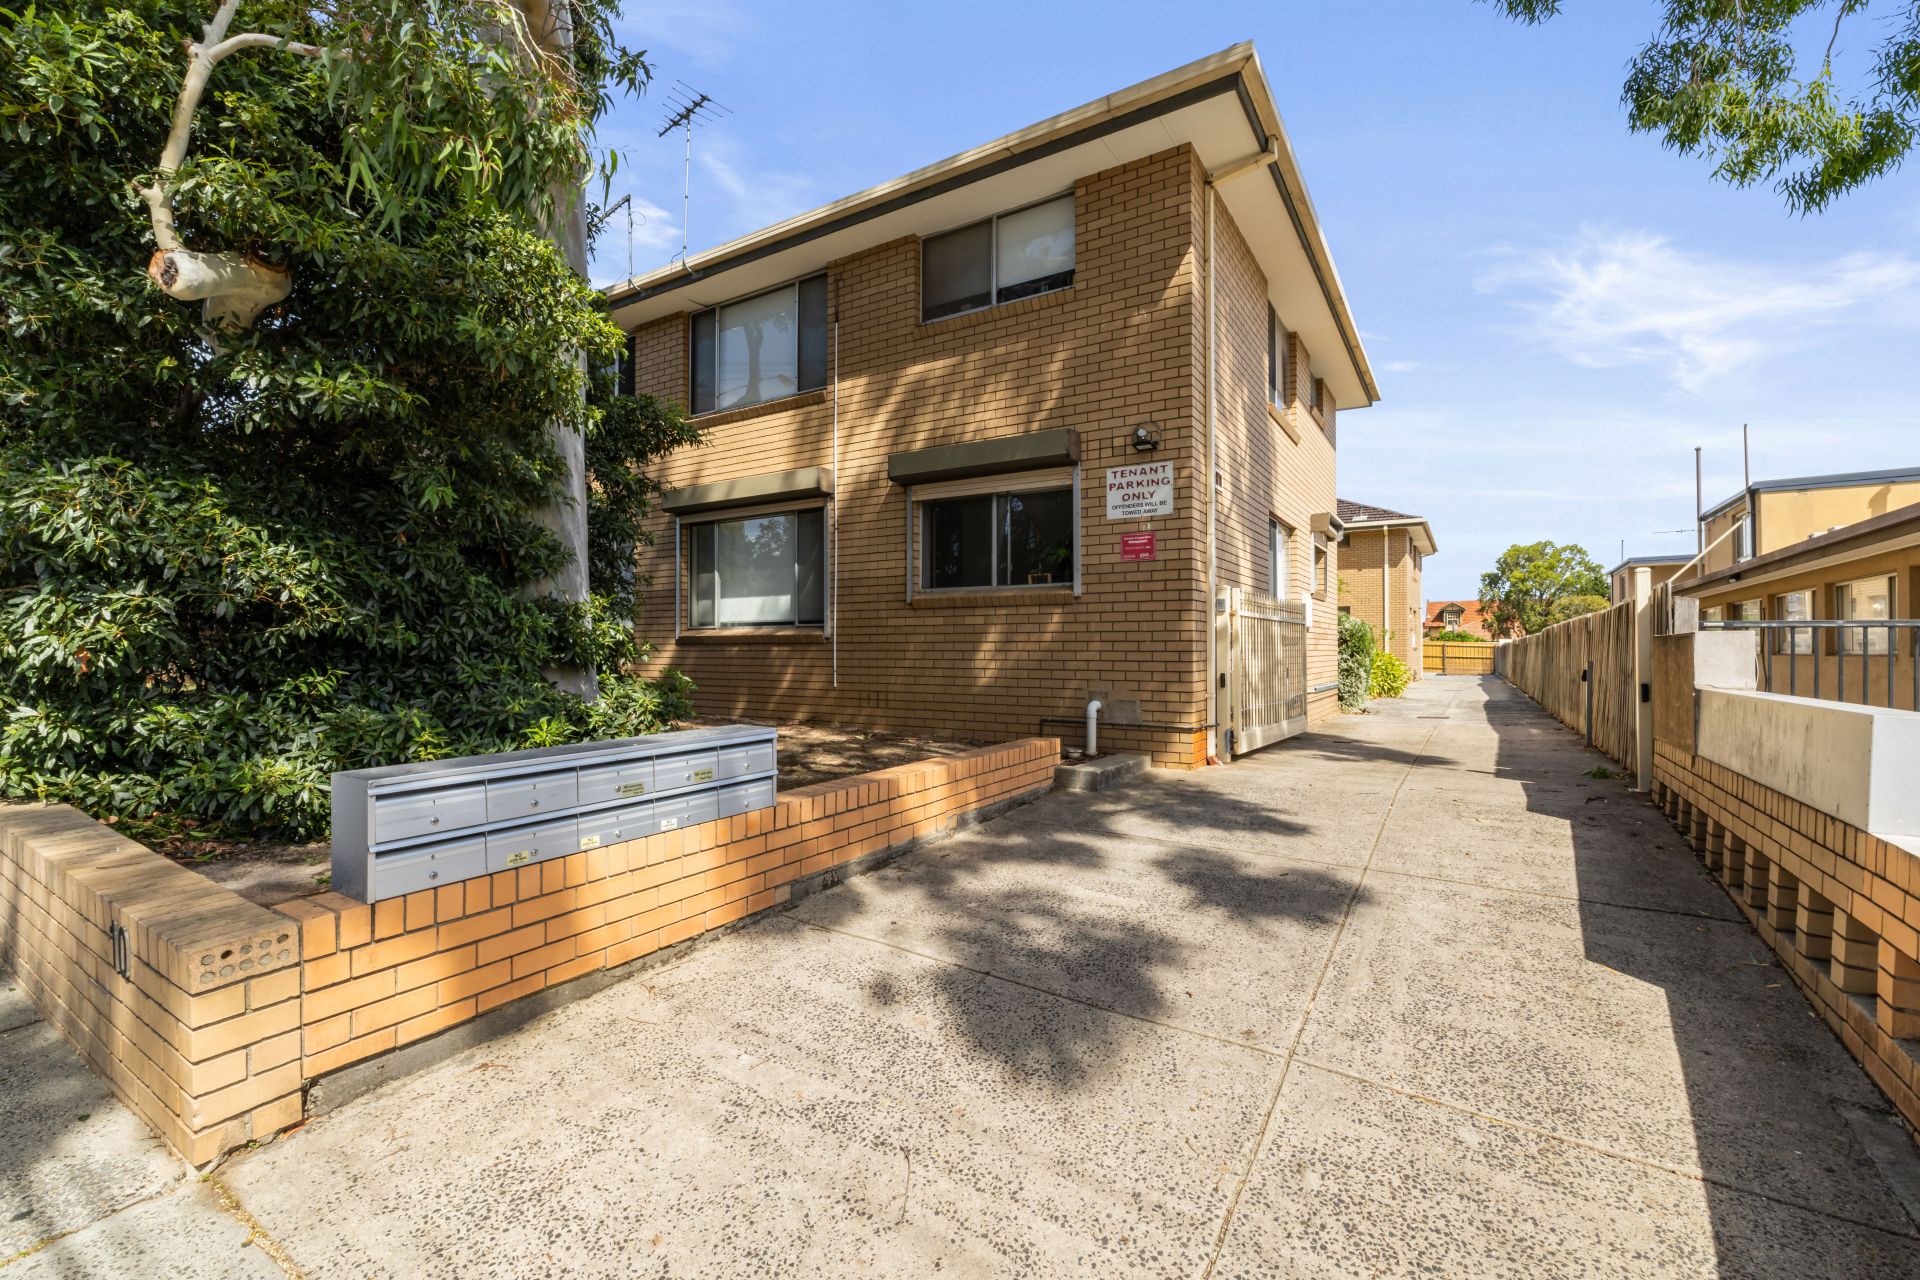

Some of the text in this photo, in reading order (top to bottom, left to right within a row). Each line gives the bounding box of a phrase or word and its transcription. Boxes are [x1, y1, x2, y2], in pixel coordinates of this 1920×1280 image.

[1111, 464, 1168, 479] TENANT
[1109, 476, 1171, 491] PARKING
[1122, 490, 1156, 502] ONLY
[1111, 502, 1144, 510] OFFENDERS
